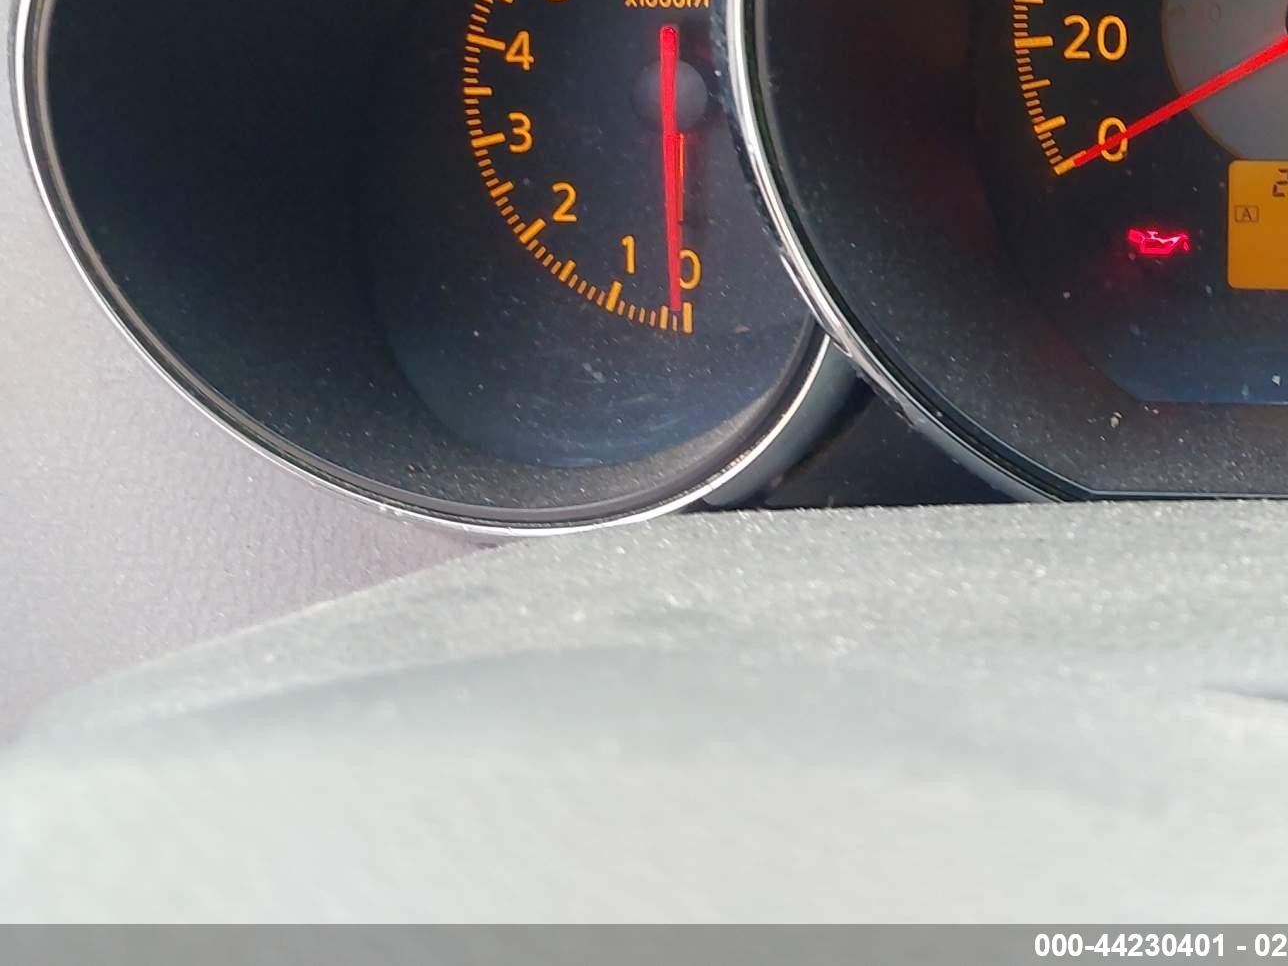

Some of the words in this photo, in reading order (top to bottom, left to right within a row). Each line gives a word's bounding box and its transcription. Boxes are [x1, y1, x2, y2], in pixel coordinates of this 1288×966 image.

[505, 31, 535, 70] 4
[1062, 15, 1128, 60] 20
[507, 112, 533, 153] 3
[1097, 117, 1129, 162] 0
[552, 182, 578, 222] 2
[620, 236, 637, 274] 1
[676, 249, 702, 289] 0
